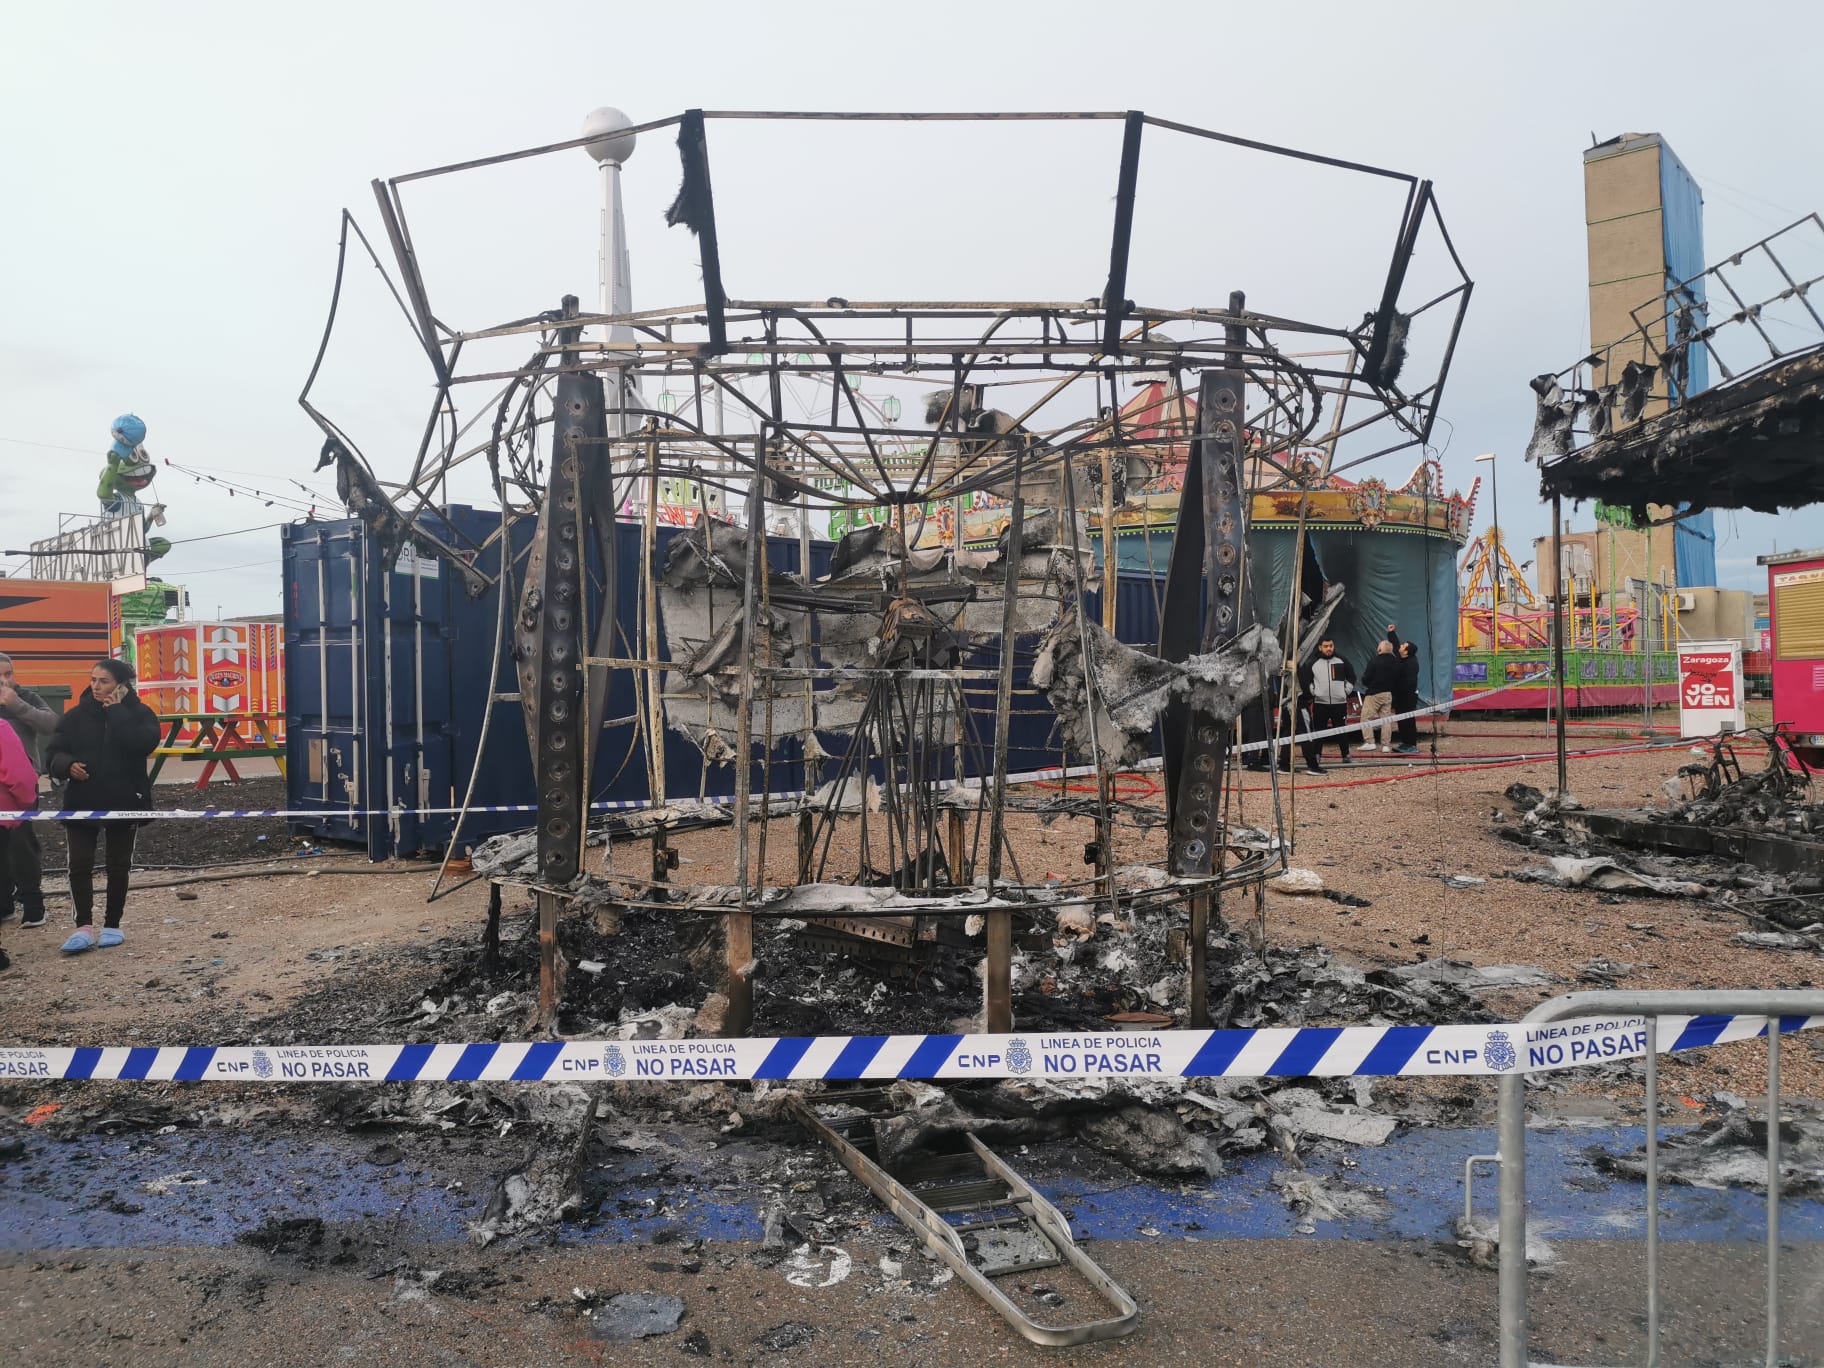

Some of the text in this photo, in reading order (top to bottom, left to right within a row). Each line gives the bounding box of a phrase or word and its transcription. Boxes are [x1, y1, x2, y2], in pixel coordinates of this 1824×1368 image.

[1779, 572, 1824, 582] TAQU
[1682, 656, 1729, 665] Zaragoza
[1684, 695, 1730, 706] VEN
[1526, 1027, 1568, 1043] LINEA
[1571, 1024, 1591, 1036] DE
[632, 1043, 736, 1055] LINEA DE POLICIA
[1041, 1037, 1162, 1050] LINEA DE POLICIA
[1529, 1031, 1647, 1067] NO PASAR
[7, 1050, 47, 1059] POLICIA
[276, 1049, 369, 1059] LINEA DE POLICIA
[1426, 1050, 1478, 1064] CNP
[217, 1062, 249, 1073] CNP
[562, 1059, 599, 1071] CNP
[636, 1057, 737, 1076] NO PASAR
[958, 1054, 1001, 1068] CNP
[1044, 1053, 1162, 1073] NO PASAR
[0, 1061, 50, 1076] PASAR
[281, 1062, 371, 1078] NO PASAR
